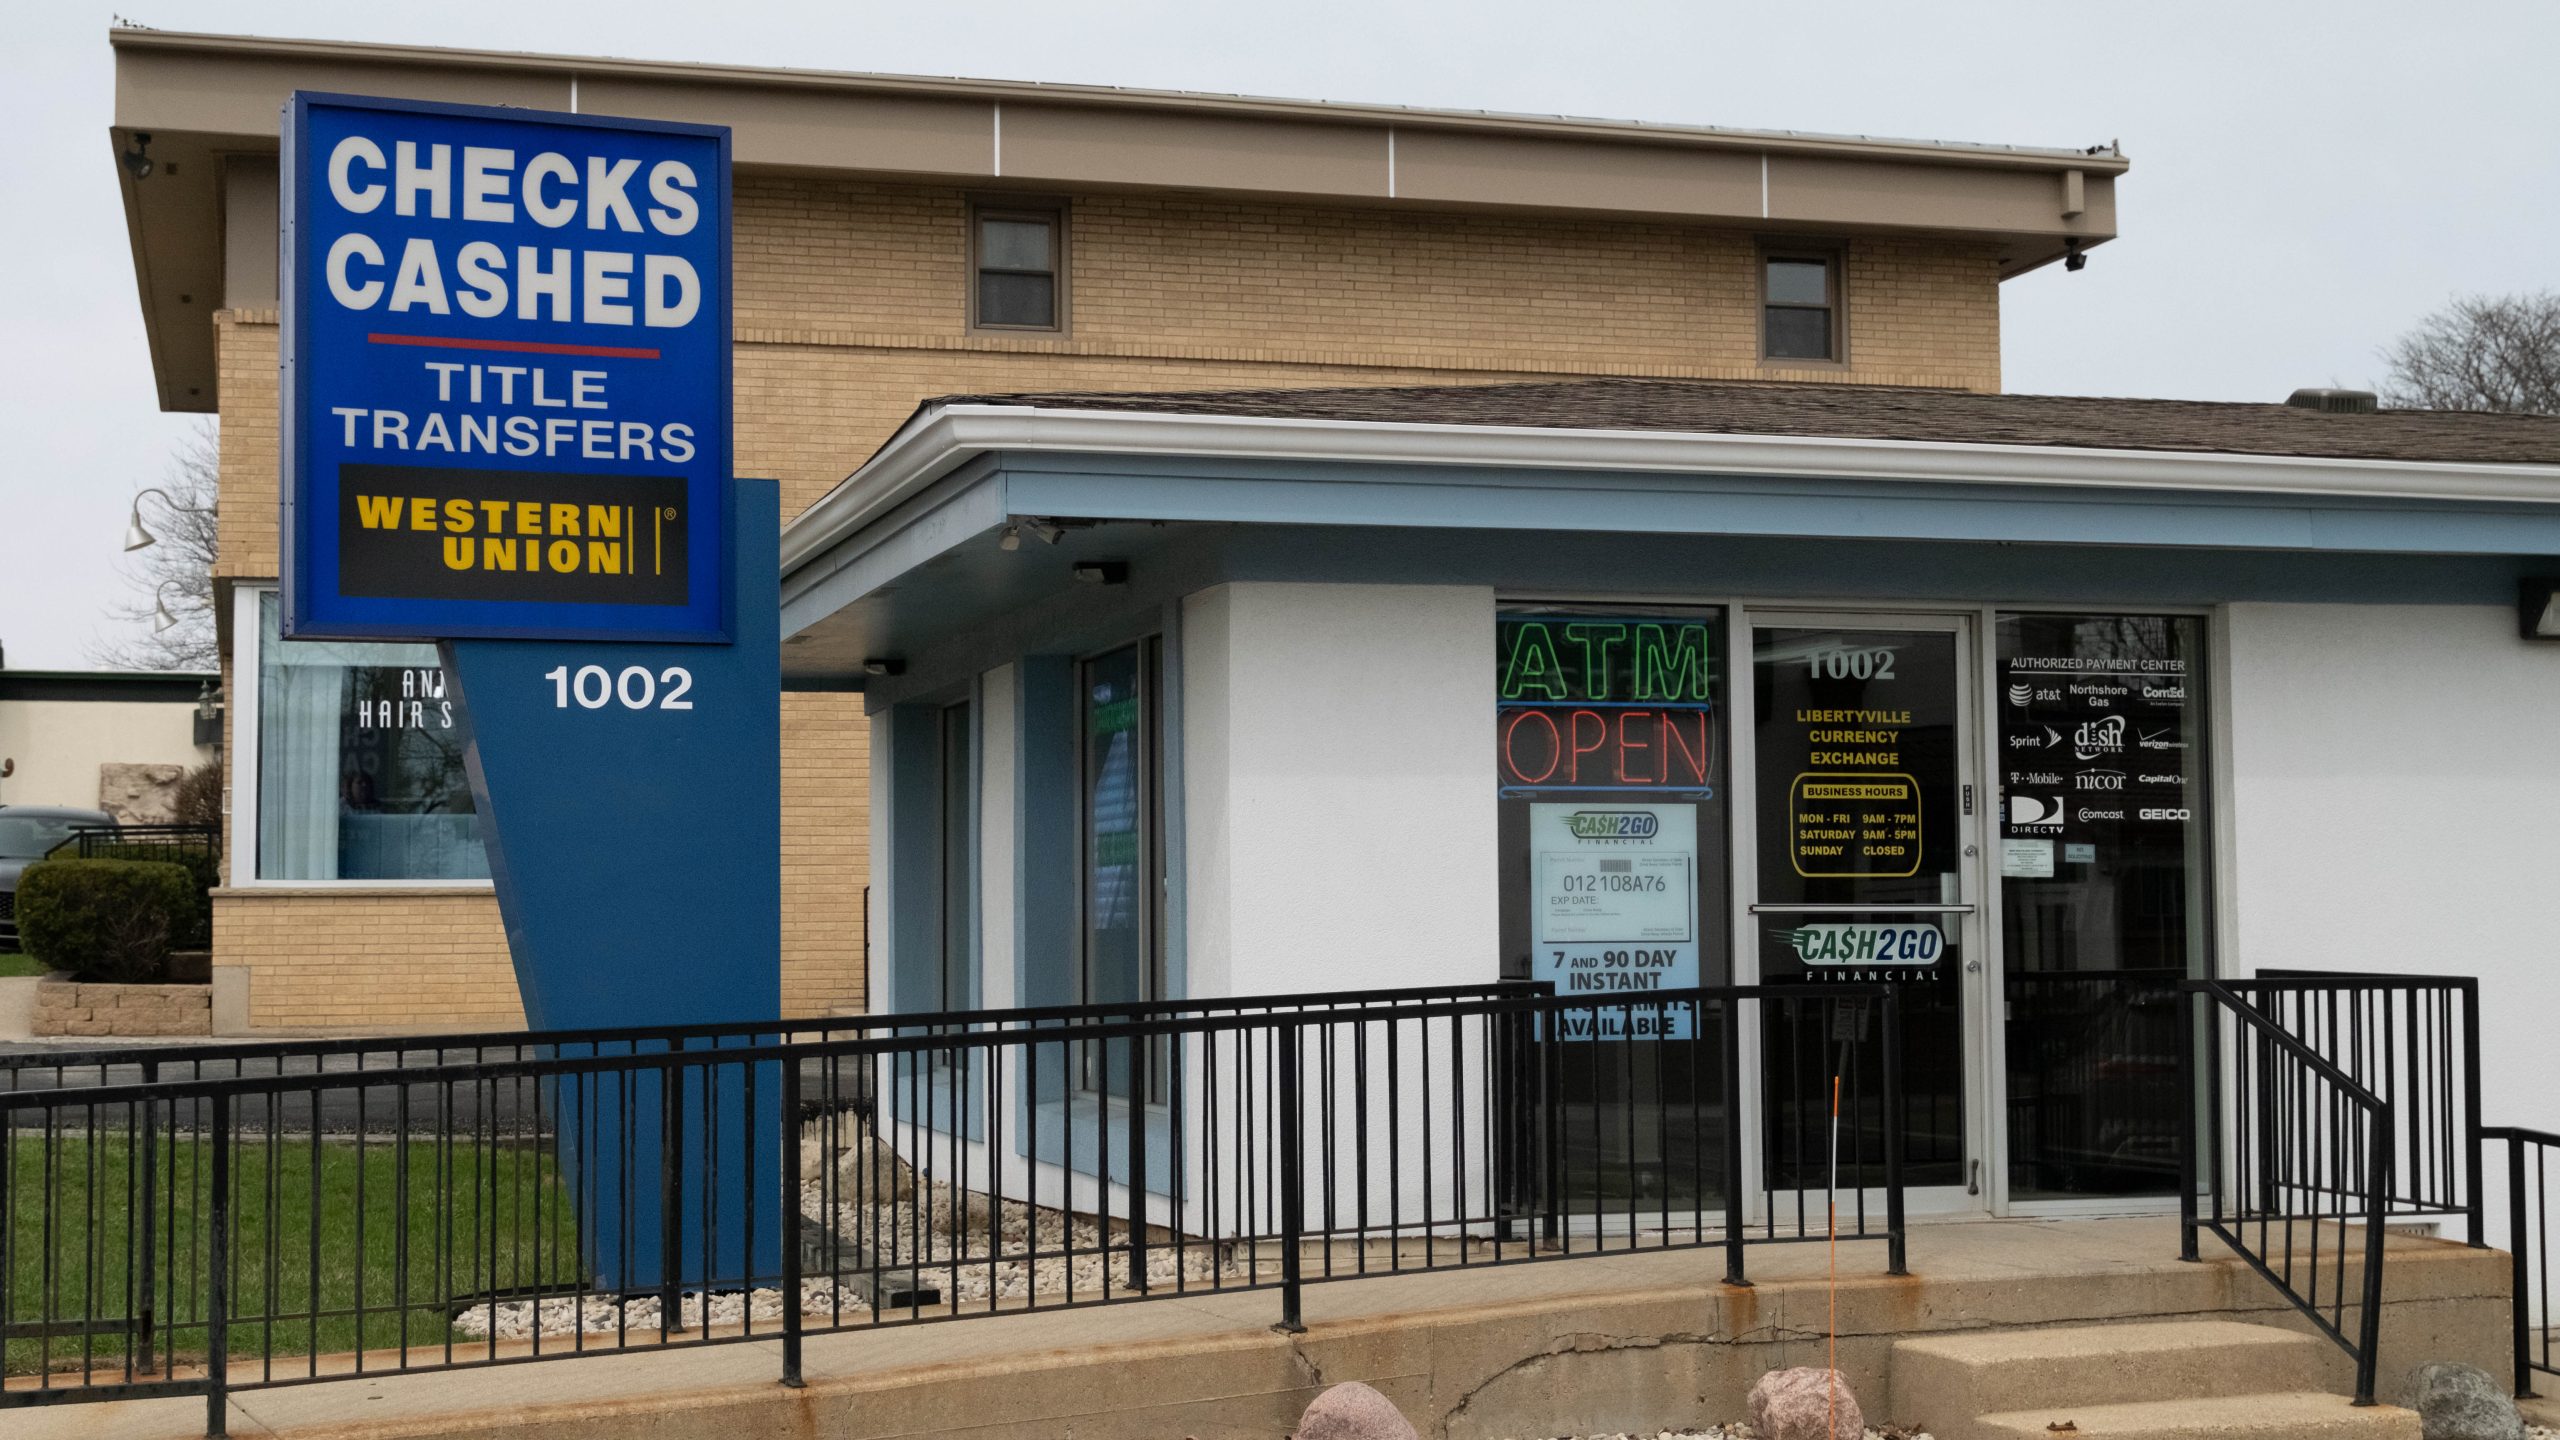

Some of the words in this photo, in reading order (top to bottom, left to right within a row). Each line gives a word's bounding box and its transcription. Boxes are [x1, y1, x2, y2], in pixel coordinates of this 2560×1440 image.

[327, 135, 700, 236] CHECKS
[326, 233, 702, 328] CASHED
[424, 362, 609, 410] TITLE
[331, 407, 696, 463] TRANSFERS
[356, 494, 621, 538] WESTERN
[443, 537, 621, 575] UNION
[1502, 622, 1709, 700] ATM
[1805, 650, 1896, 680] 1002
[2010, 657, 2084, 669] AUTHORIZED
[2086, 658, 2138, 670] PAYMENT
[2140, 659, 2185, 671] CENTER
[545, 665, 693, 710] 1002
[2036, 688, 2062, 701] at&t
[2069, 684, 2128, 695] Northshore
[2088, 696, 2110, 707] Gas
[359, 700, 424, 728] HAIR
[1796, 709, 1911, 724] LIBERTYVILLE
[1809, 730, 1899, 744] CURRENCY
[2010, 735, 2041, 749] Sprint
[2074, 721, 2124, 747] dish
[1506, 710, 1705, 784] OPEN
[1810, 751, 1899, 765] EXCHANGE
[2075, 773, 2127, 790] nicor
[1807, 787, 1862, 796] BUSINESS
[1865, 787, 1903, 796] HOURS
[1799, 813, 1824, 823] MON
[1833, 814, 1851, 823] FRI
[1862, 814, 1885, 824] 9AM
[1894, 814, 1916, 823] 7PM
[2139, 808, 2191, 820] GEICO
[1799, 830, 1856, 840] SATURDAY
[1862, 830, 1885, 840] 9AM
[1894, 830, 1916, 840] 5PM
[2011, 826, 2064, 834] DIRECTV
[1800, 846, 1844, 856] SUNDAY
[1863, 846, 1905, 856] CLOSED
[1563, 874, 1666, 892] 012108A76
[1551, 896, 1570, 905] EXP
[1800, 926, 1938, 963] CA$H2GO
[1553, 951, 1565, 969] 7
[1571, 957, 1599, 969] AND
[1603, 950, 1630, 968] 90
[1635, 949, 1678, 968] DAY
[1569, 971, 1662, 990] INSTANT
[1806, 971, 1939, 981] FINANCIAL
[1557, 1016, 1675, 1036] AVAILABLE
